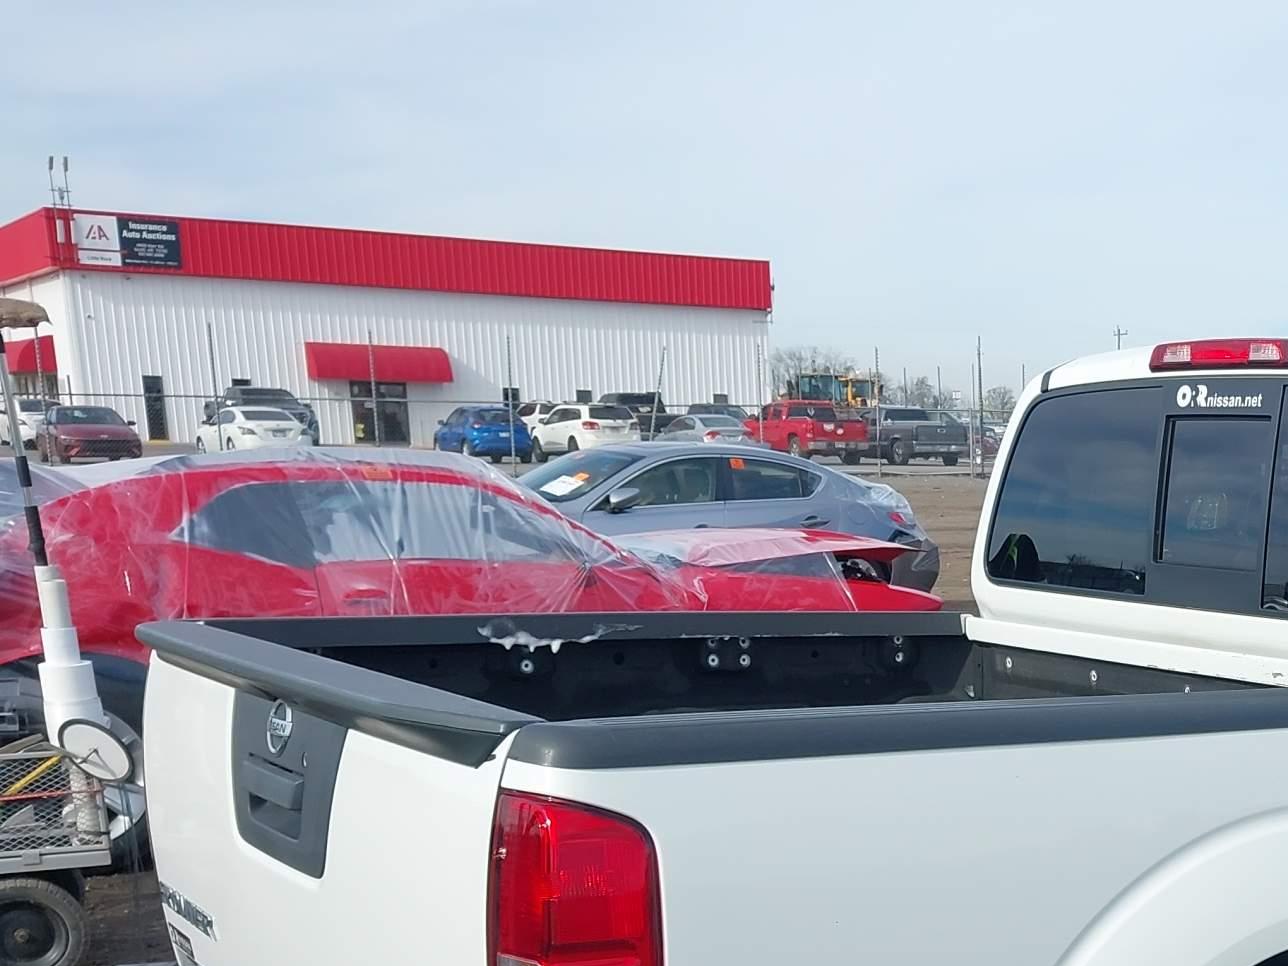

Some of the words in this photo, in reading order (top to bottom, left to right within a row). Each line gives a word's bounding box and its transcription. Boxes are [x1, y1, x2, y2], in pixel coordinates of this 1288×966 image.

[129, 221, 167, 231] Insurance
[122, 230, 141, 239] Auto
[142, 231, 176, 240] Auctions
